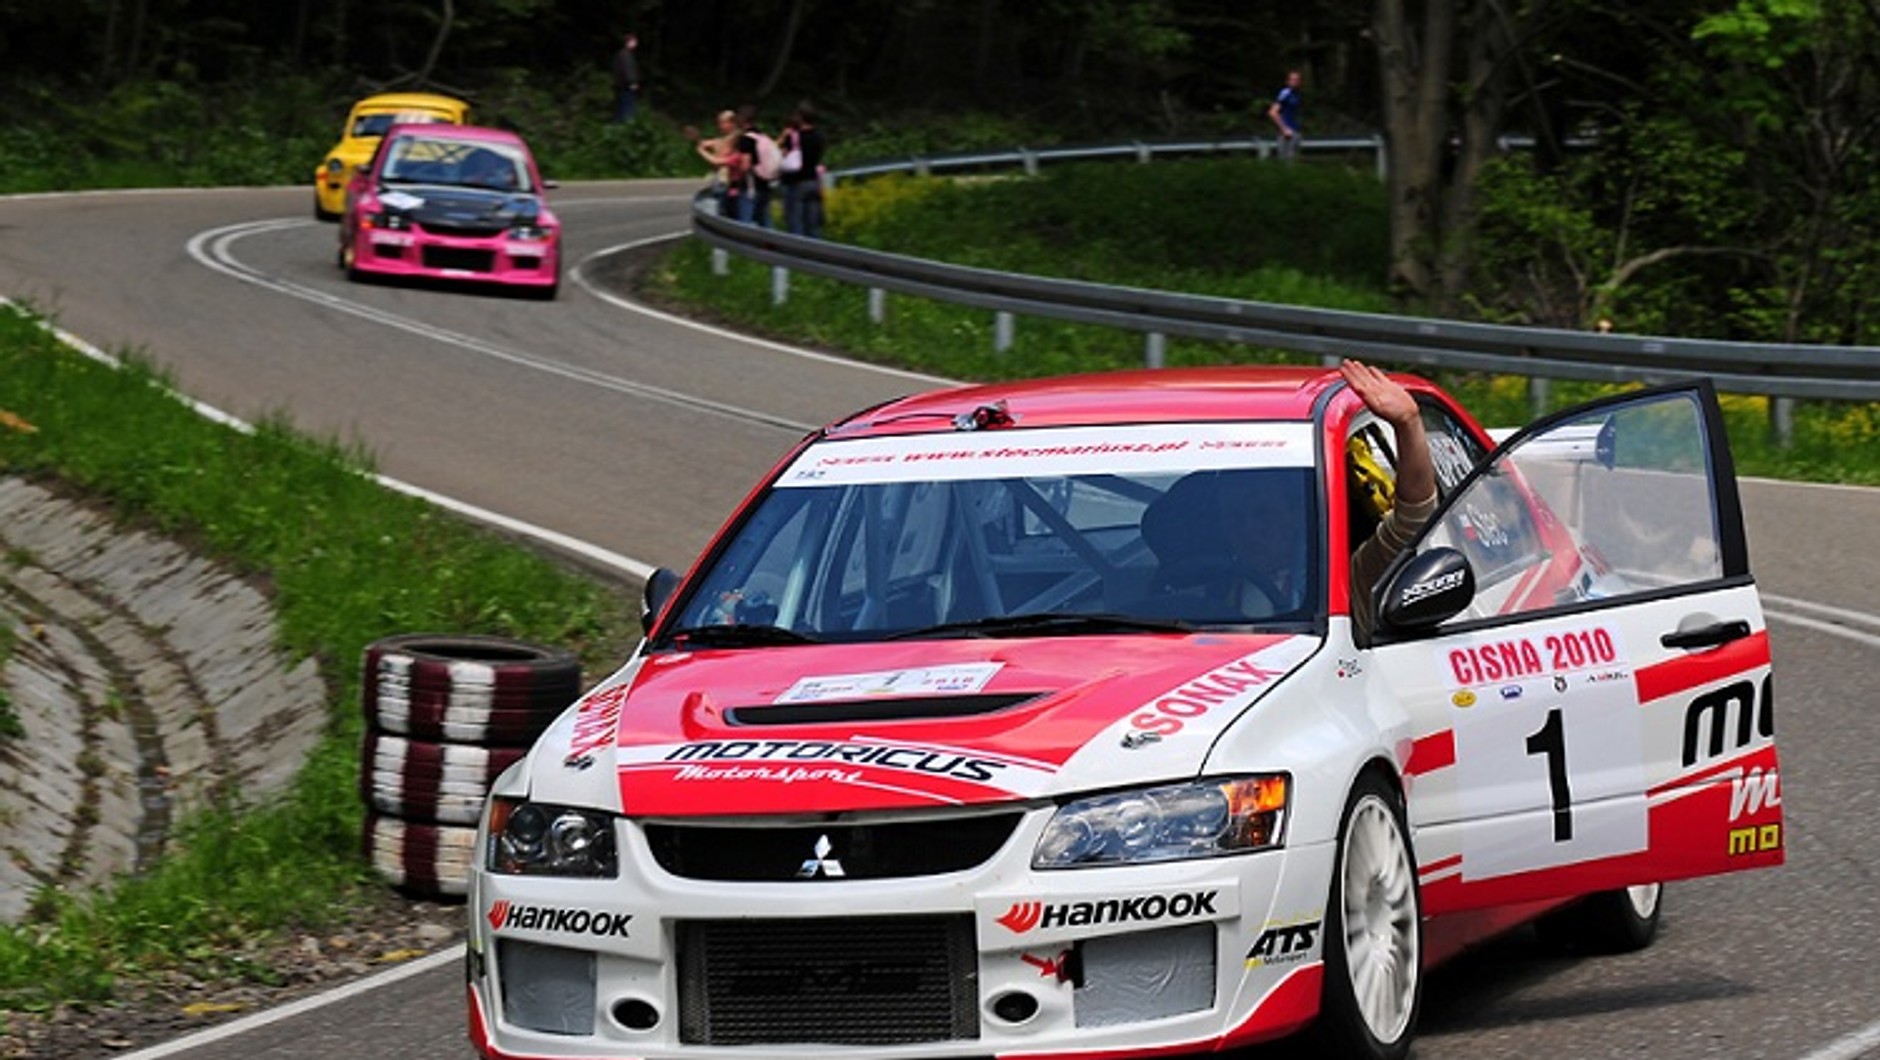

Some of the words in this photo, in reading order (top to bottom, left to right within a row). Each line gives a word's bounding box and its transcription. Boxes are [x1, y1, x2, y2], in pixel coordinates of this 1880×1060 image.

[1450, 639, 1542, 685] CISNA
[1545, 627, 1616, 672] 2010
[1130, 660, 1284, 736] SONAX
[664, 741, 1006, 782] MOTORICUS
[672, 763, 863, 783] Motorsport
[1525, 708, 1573, 842] 1
[1246, 920, 1322, 960] ATS
